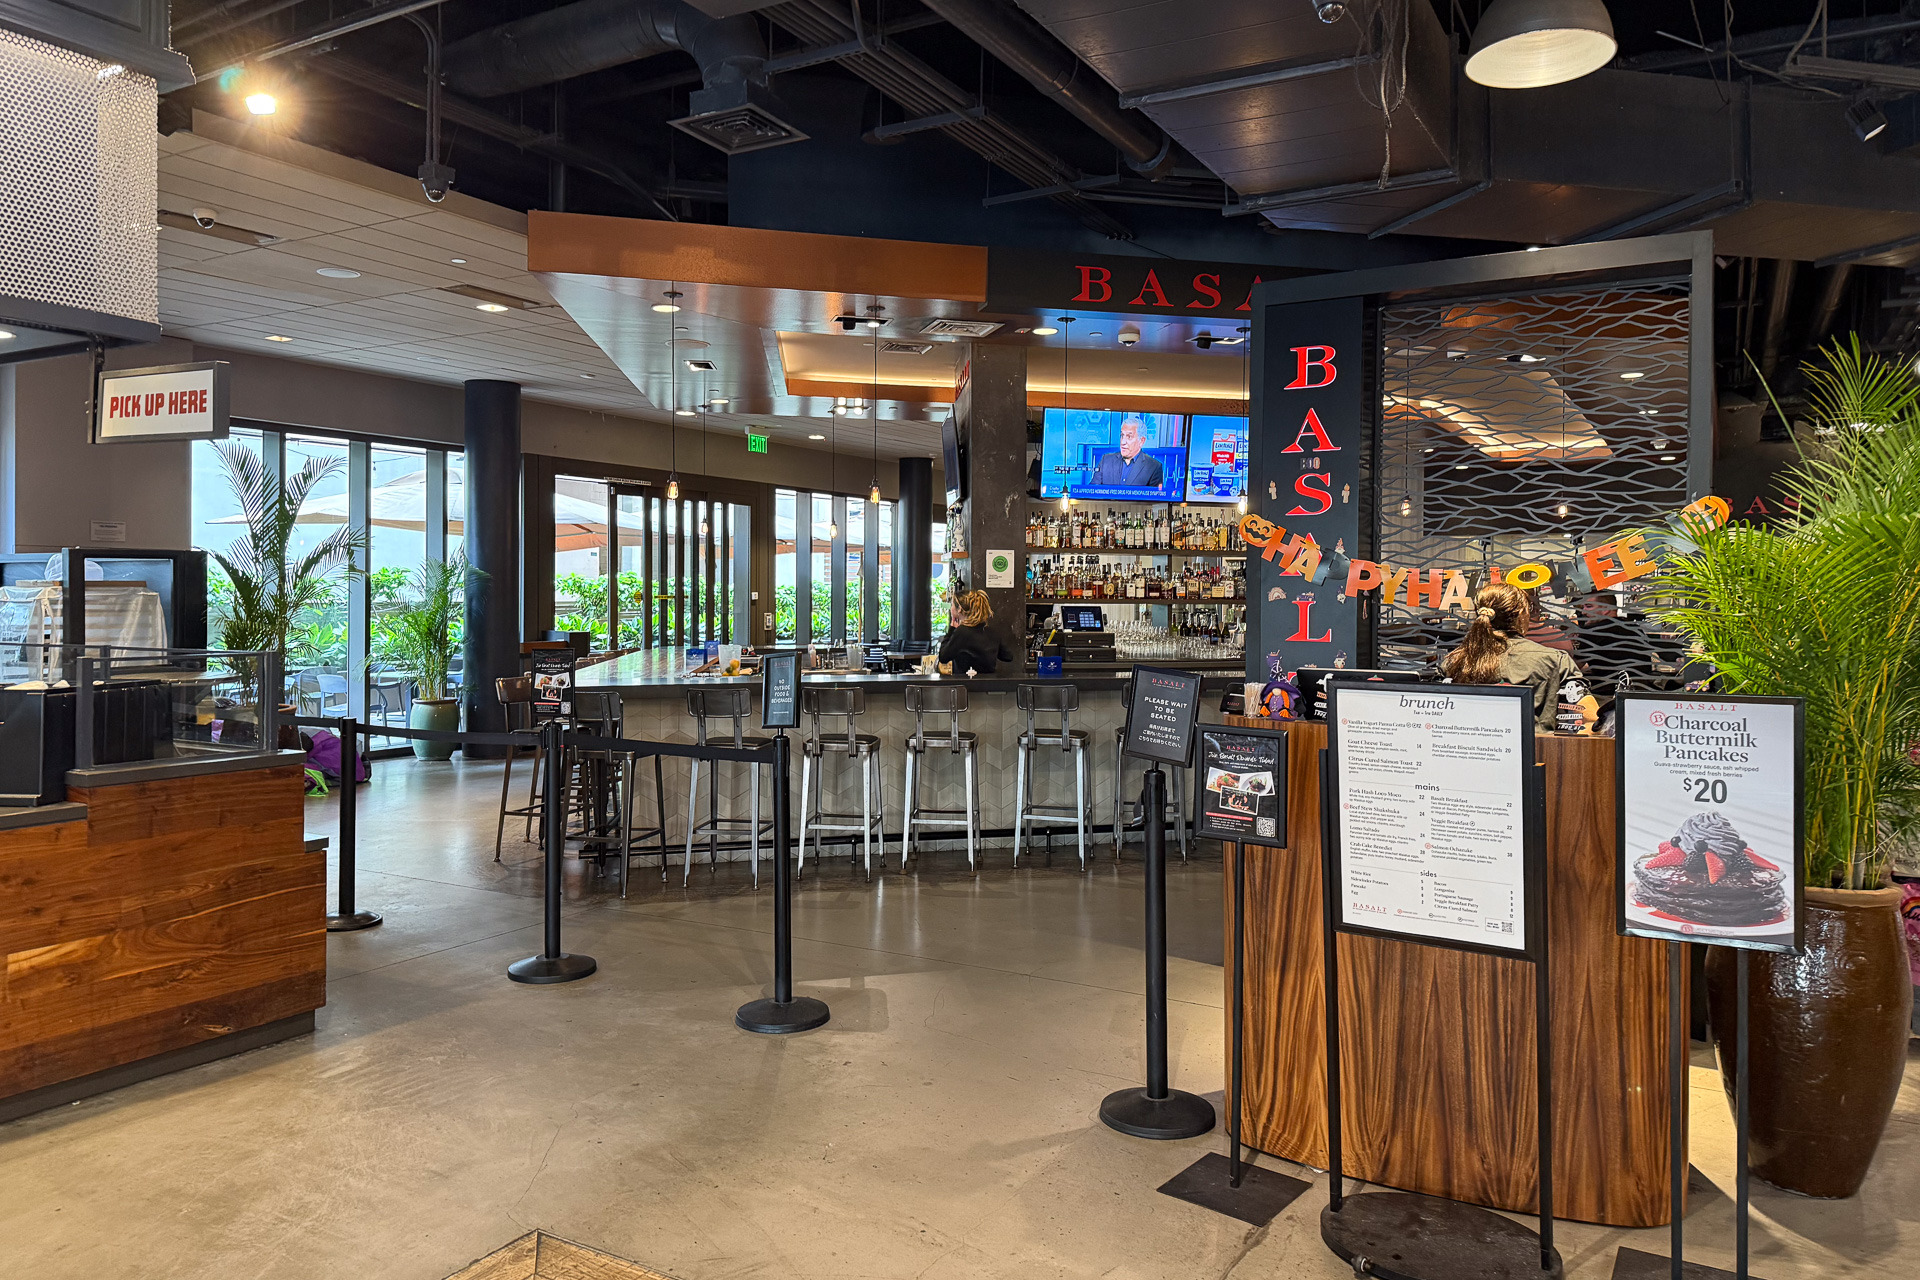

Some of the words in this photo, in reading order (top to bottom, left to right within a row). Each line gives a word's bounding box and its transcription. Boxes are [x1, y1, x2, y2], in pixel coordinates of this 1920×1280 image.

[110, 395, 141, 419] PICK
[145, 393, 165, 416] UP
[168, 389, 207, 415] HERE
[751, 435, 766, 452] EXIT
[1144, 696, 1169, 705] PLEASE
[1171, 701, 1187, 709] WAIT
[1400, 695, 1455, 710] brunch
[1674, 703, 1737, 711] BASALT
[1150, 713, 1176, 722] SEATED
[1664, 715, 1747, 732] Charcoal
[1656, 730, 1758, 748] Buttermilk
[1664, 745, 1749, 763] Pancakes
[1415, 783, 1440, 791] mains
[1683, 777, 1727, 804] $20
[1353, 902, 1386, 912] BASALT
